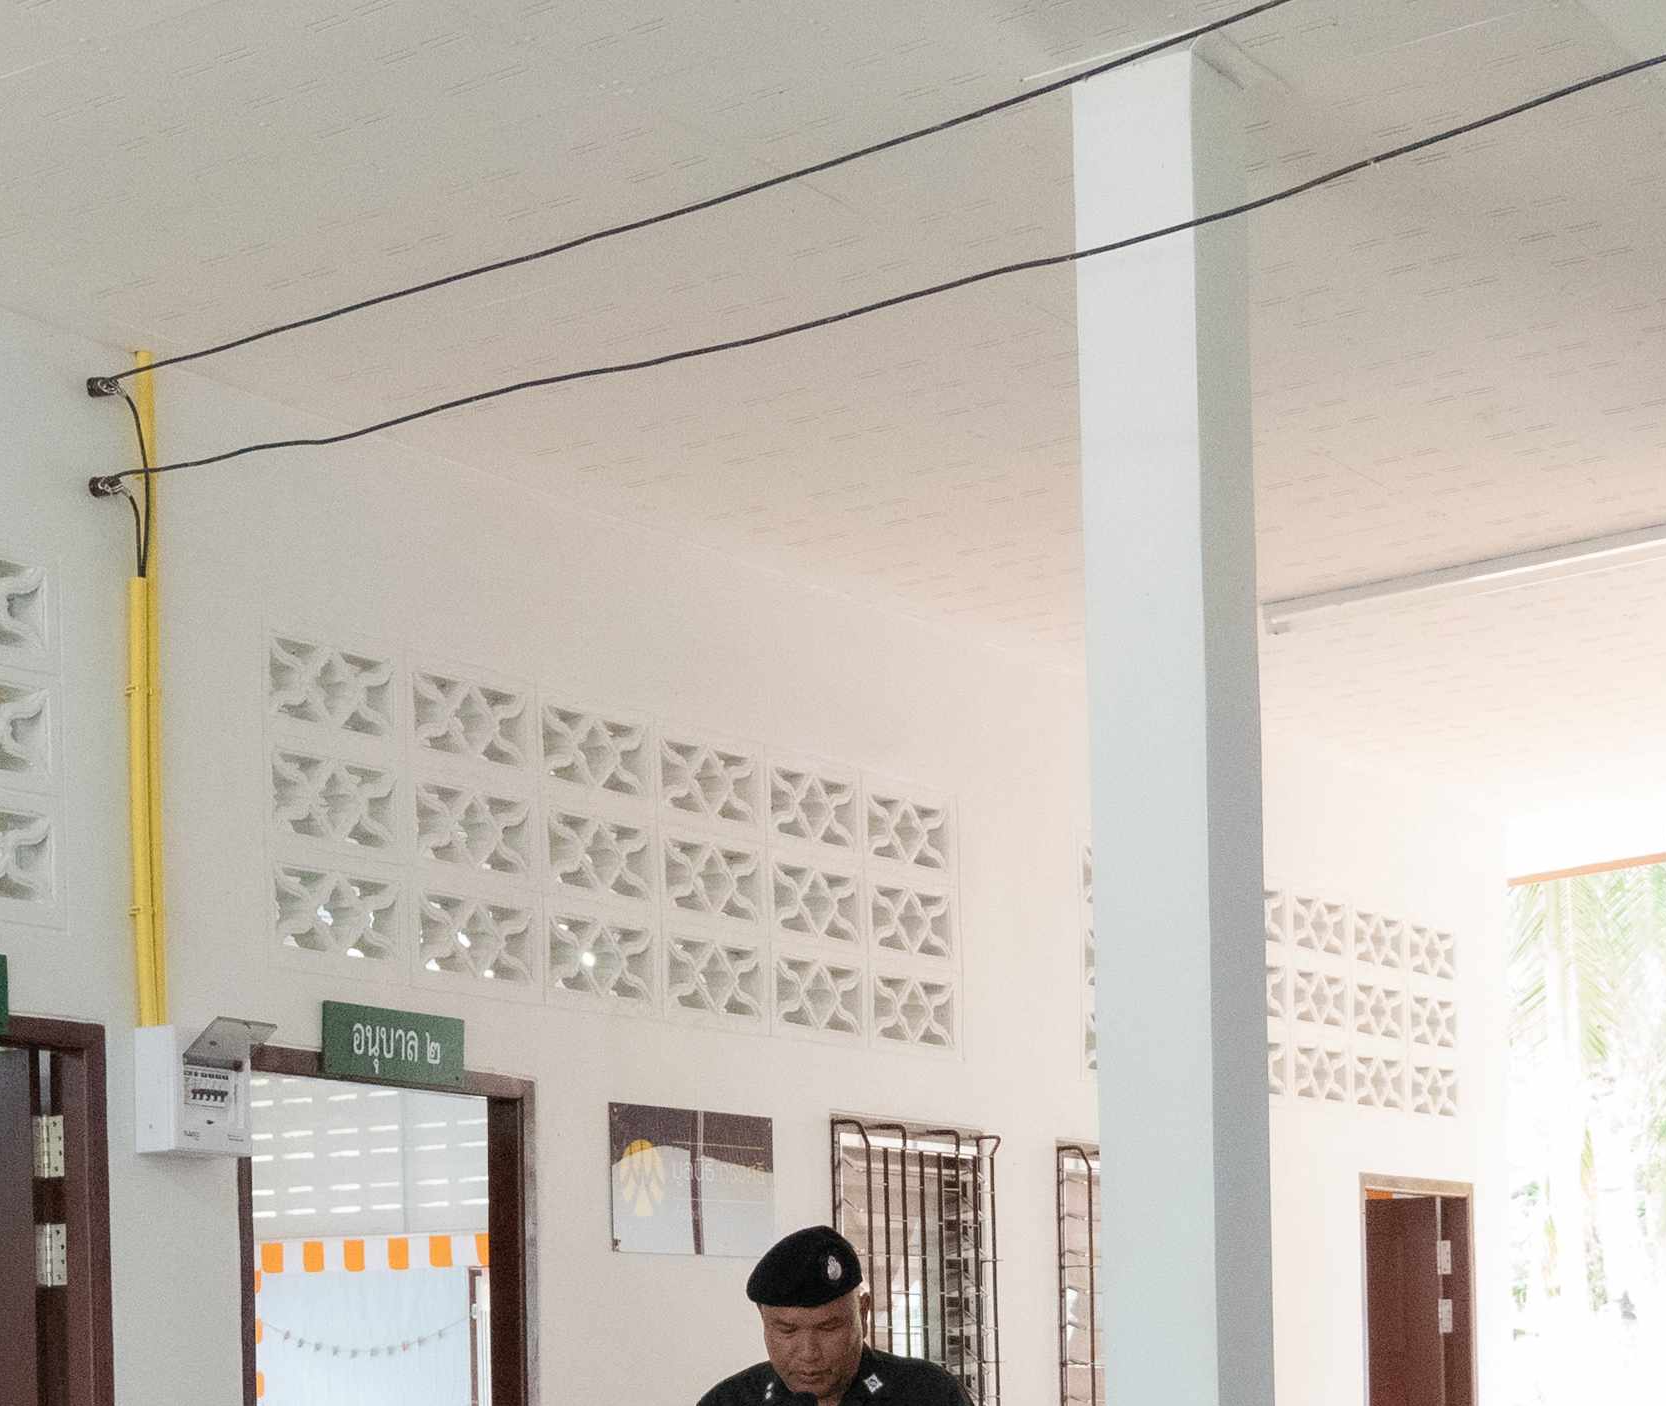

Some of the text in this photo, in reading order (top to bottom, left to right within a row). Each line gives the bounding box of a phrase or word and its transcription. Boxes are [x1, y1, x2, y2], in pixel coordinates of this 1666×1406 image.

[352, 1022, 441, 1075] อนุบาล ๒
